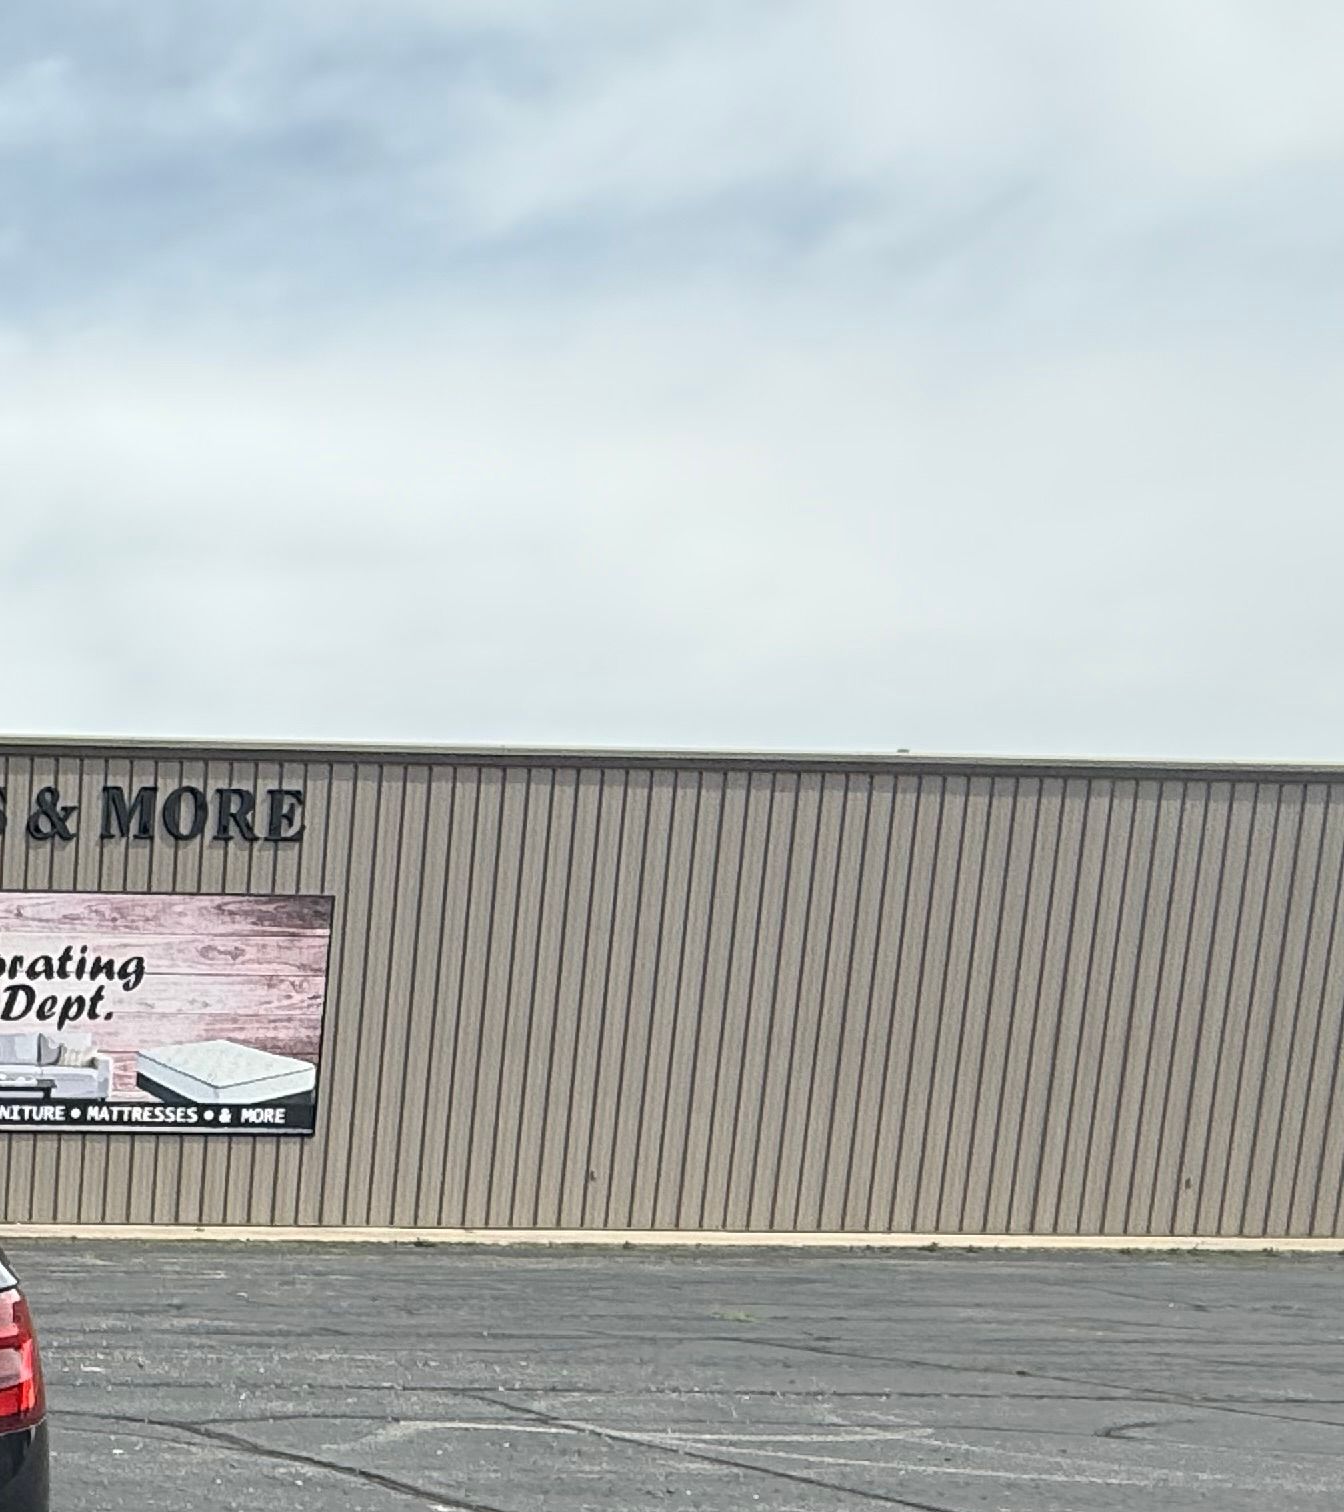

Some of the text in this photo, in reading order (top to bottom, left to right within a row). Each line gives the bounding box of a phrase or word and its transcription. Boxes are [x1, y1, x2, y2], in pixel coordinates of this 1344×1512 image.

[27, 786, 79, 841] &
[100, 786, 306, 842] MORE
[0, 984, 113, 1030] Dept.
[86, 1106, 198, 1123] MATTRESSES
[218, 1109, 232, 1124] &
[240, 1109, 286, 1124] MORE
